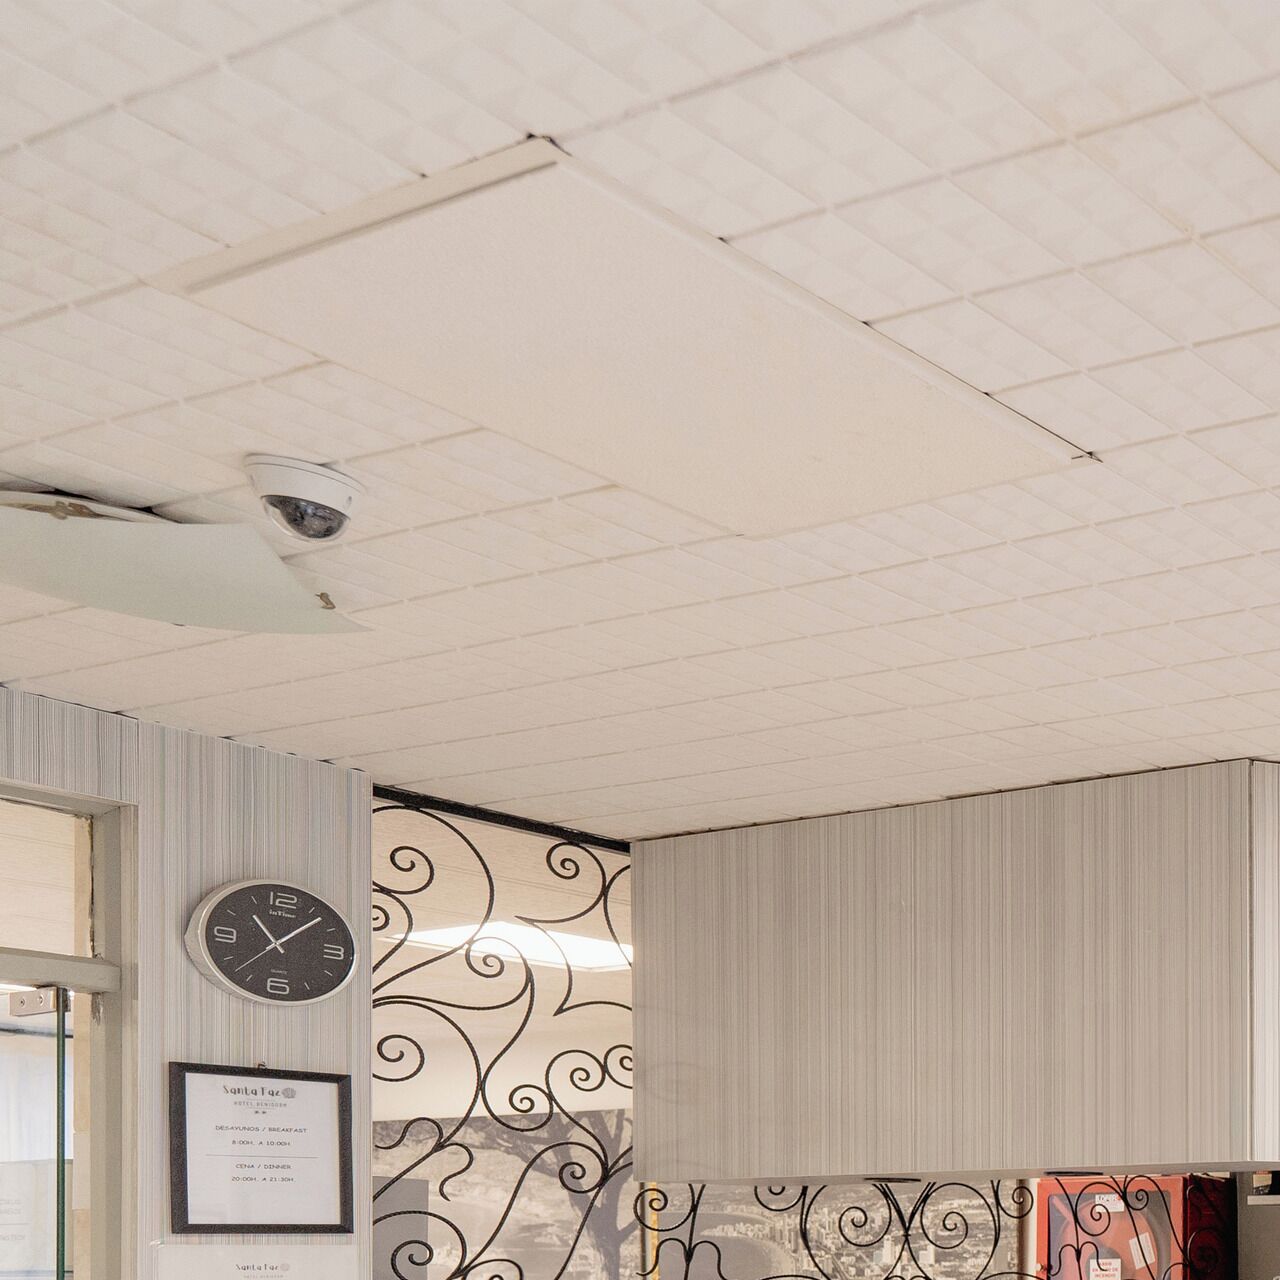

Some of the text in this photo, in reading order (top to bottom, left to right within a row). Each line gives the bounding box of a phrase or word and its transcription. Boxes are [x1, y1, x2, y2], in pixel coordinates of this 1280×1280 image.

[270, 891, 297, 909] 12
[214, 926, 237, 943] 9
[323, 944, 344, 960] 3
[267, 977, 289, 994] 6
